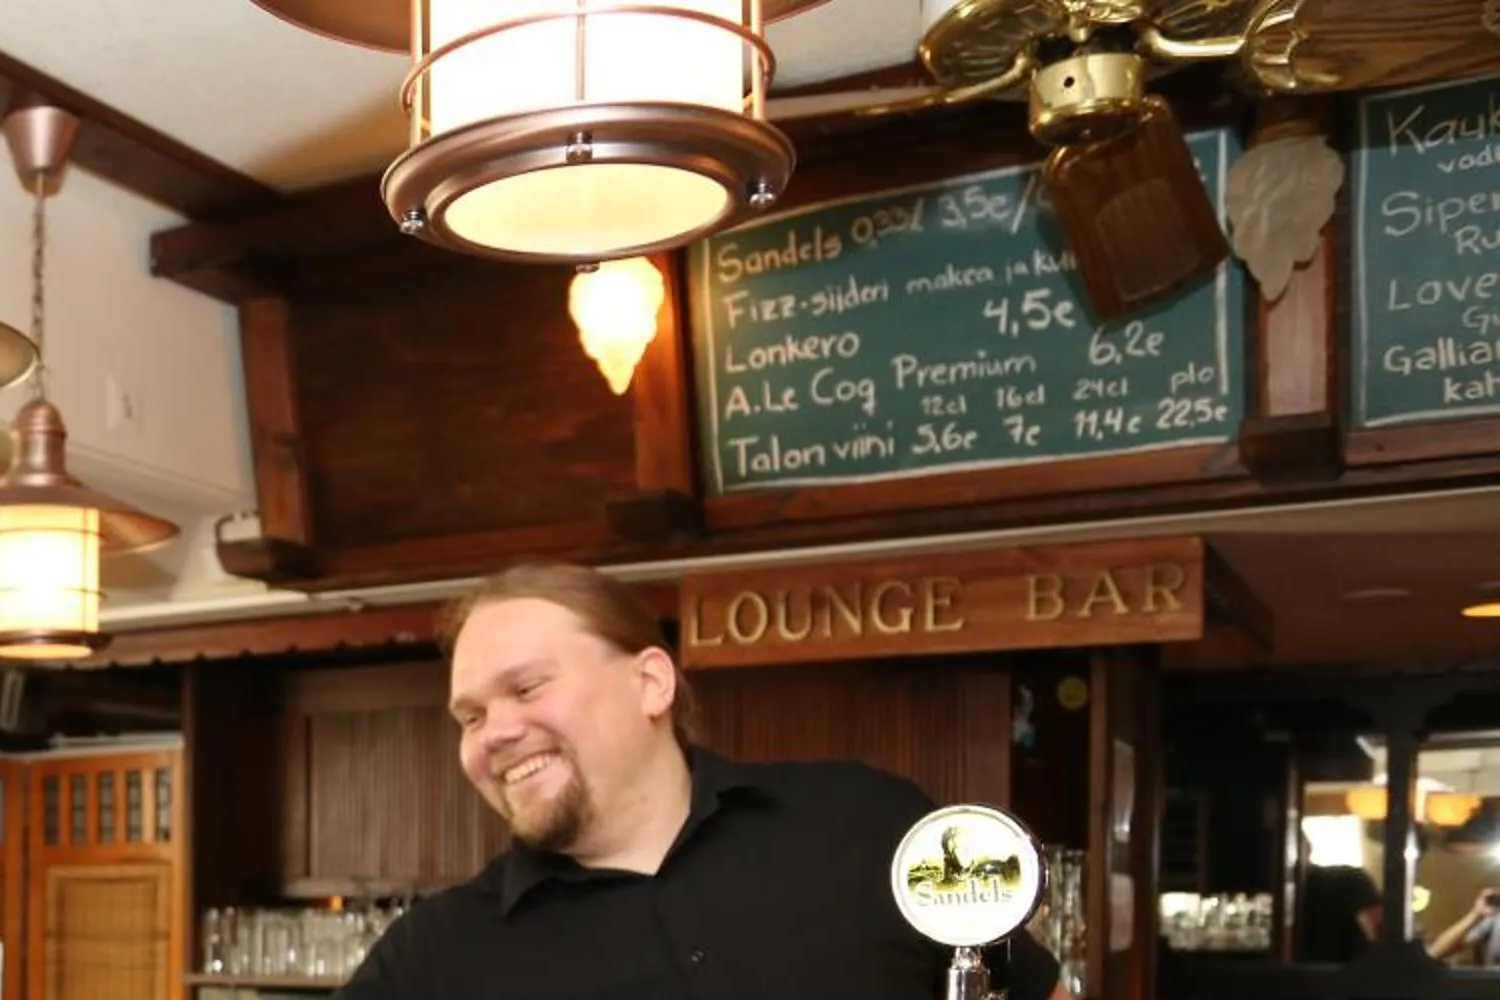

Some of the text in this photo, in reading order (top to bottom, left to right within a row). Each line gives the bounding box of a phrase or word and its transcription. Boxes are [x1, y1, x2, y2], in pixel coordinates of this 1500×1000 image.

[718, 225, 842, 283] Sandels
[906, 263, 994, 294] makea
[725, 332, 860, 373] Lonkero
[891, 349, 1037, 390] Premium
[728, 435, 826, 477] Talon
[1003, 415, 1041, 446] 7e
[688, 563, 1185, 647] LOUNGE BAR
[916, 880, 1013, 907] Sandels
